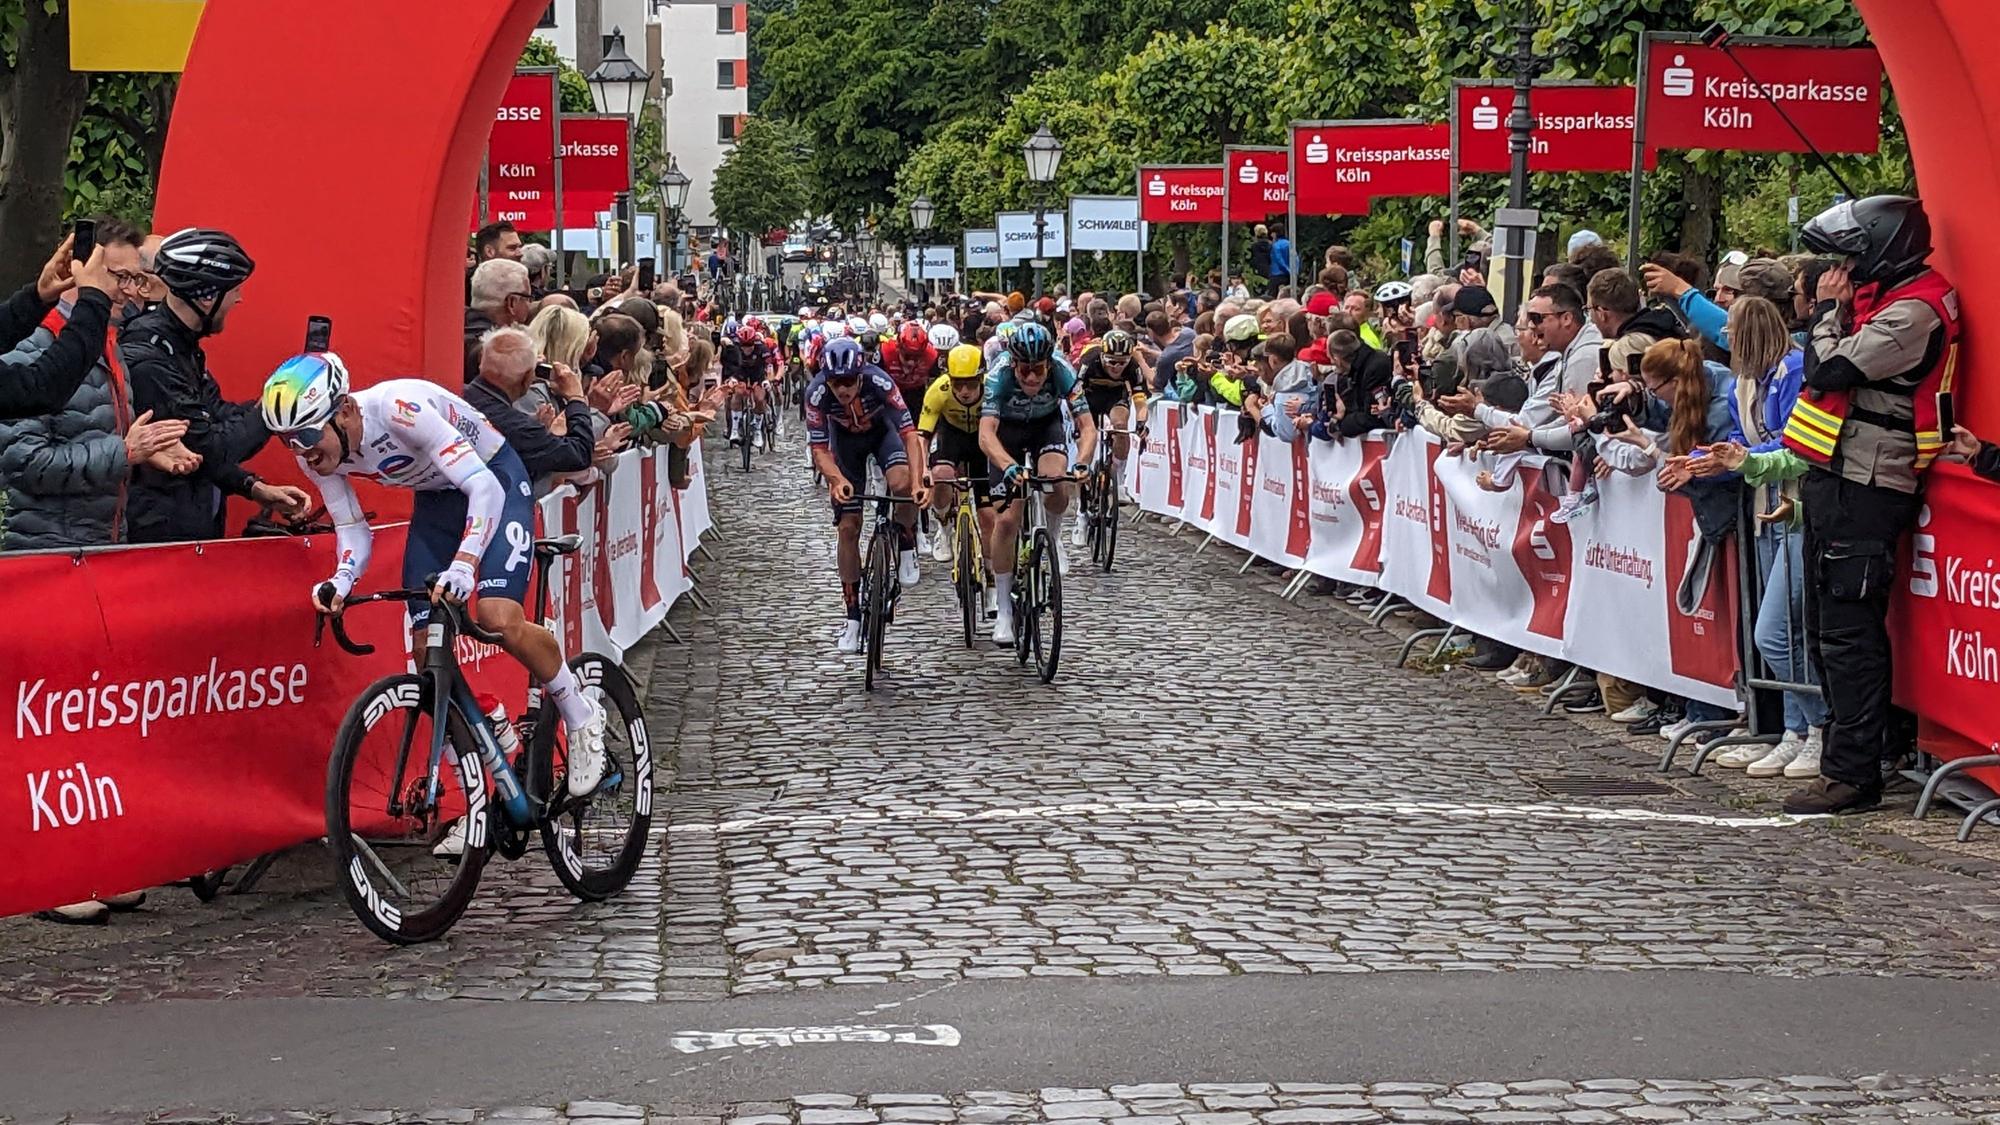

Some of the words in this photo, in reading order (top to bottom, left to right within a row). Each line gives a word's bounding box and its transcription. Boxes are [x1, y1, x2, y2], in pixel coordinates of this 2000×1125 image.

[1705, 77, 1868, 103] Kreissparkasse
[1704, 106, 1752, 128] Köln
[1336, 146, 1450, 164] Kreissparkasse
[499, 163, 536, 178] Köln
[1336, 168, 1371, 182] Köln
[1170, 199, 1197, 211] Köln
[1078, 219, 1138, 230] SCHWALBE
[1946, 556, 2000, 610] Kreis
[1947, 629, 1998, 683] Köln
[16, 656, 307, 739] Kreissparkasse
[27, 762, 124, 831] Köln
